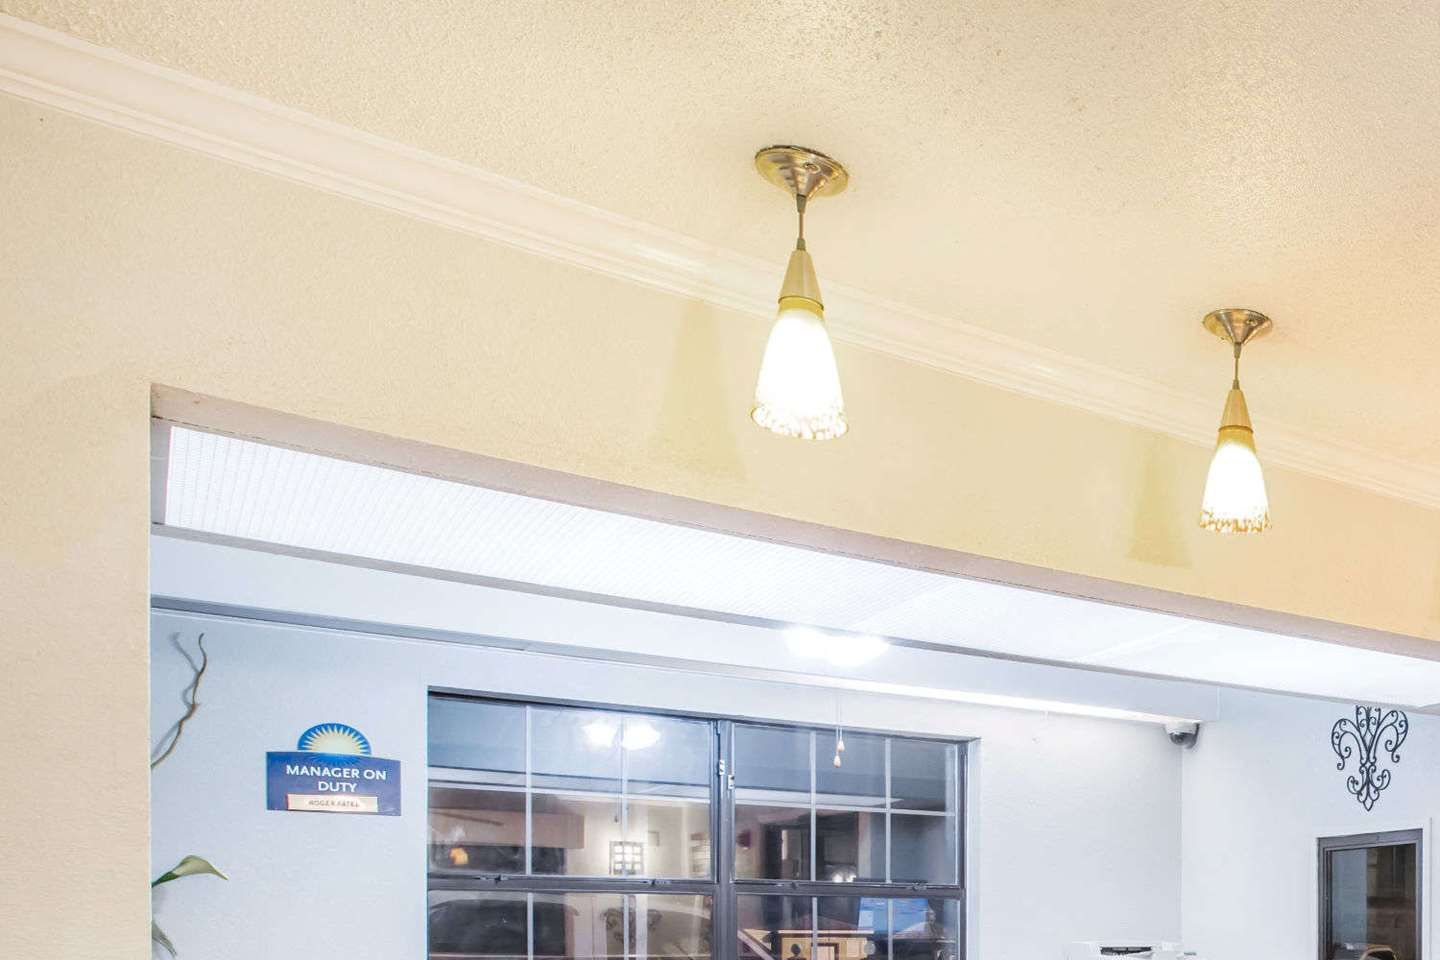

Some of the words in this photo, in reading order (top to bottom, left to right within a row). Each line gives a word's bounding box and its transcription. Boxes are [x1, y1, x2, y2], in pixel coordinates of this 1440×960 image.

[286, 764, 360, 779] MANAGER
[363, 769, 387, 780] ON
[318, 781, 358, 793] DUTY
